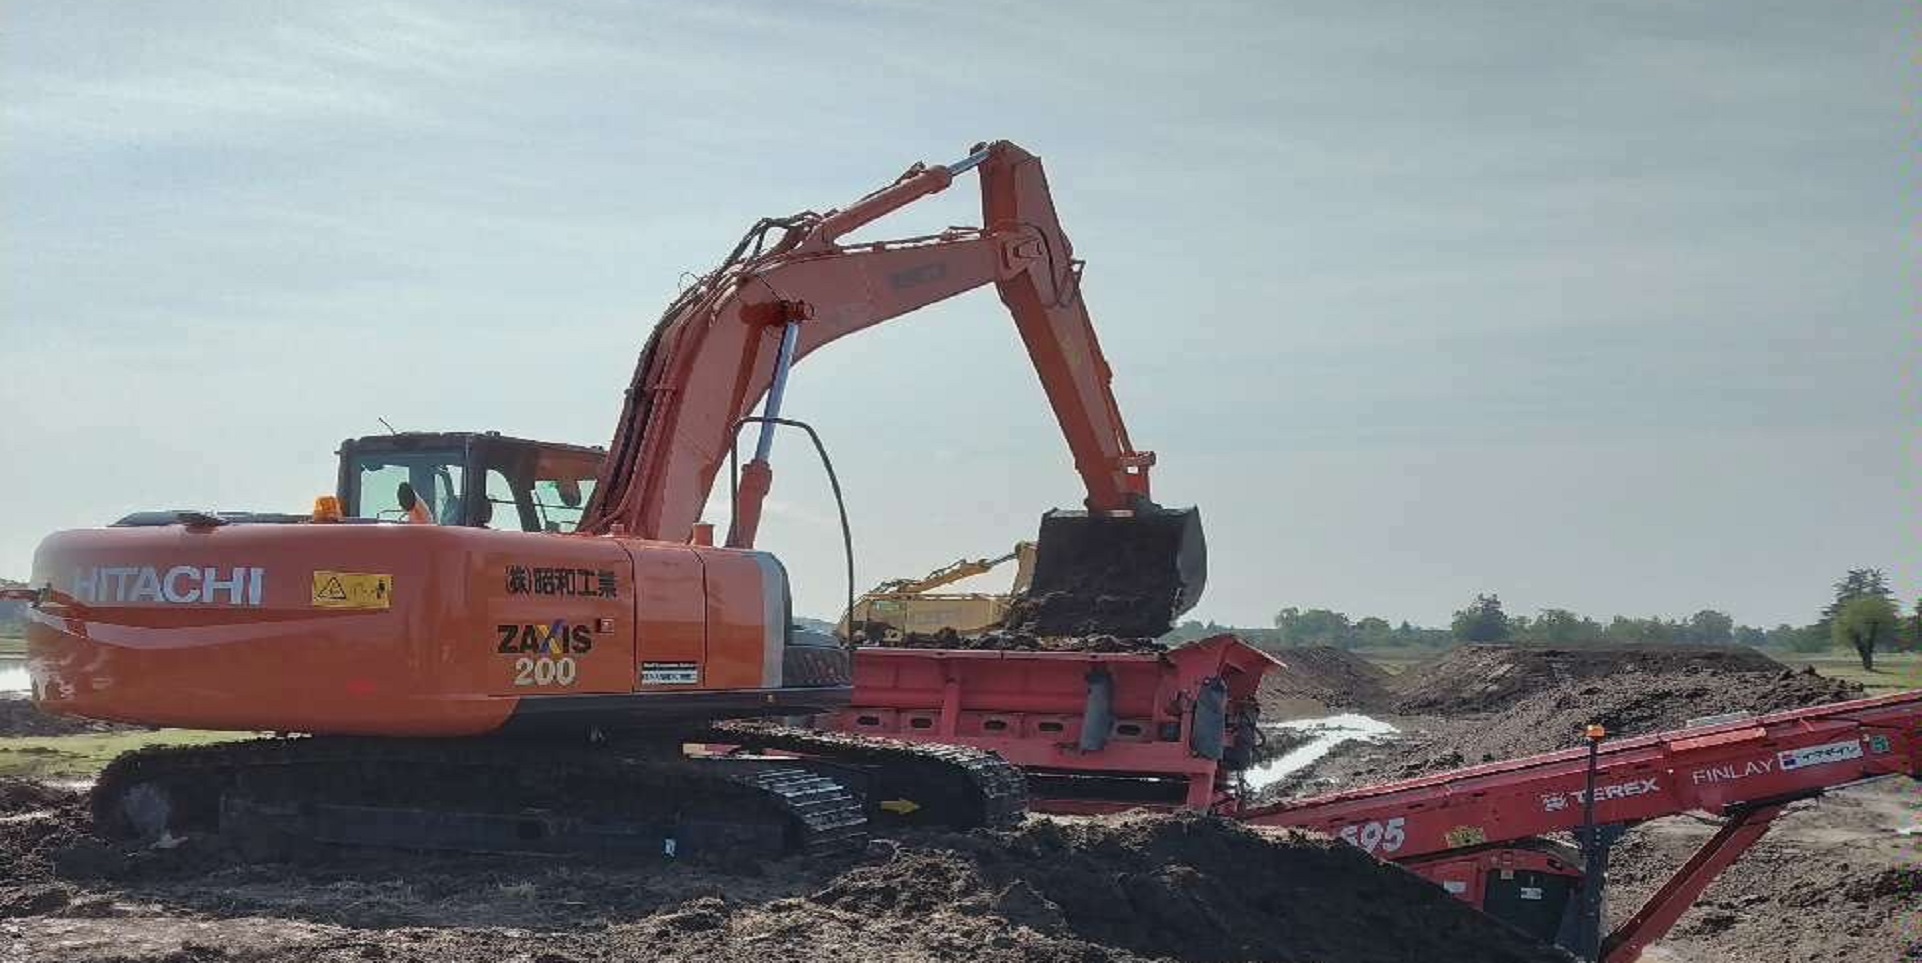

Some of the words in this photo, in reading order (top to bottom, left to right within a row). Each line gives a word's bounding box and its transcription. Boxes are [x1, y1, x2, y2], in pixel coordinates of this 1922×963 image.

[73, 565, 265, 604] HITACHI
[497, 618, 593, 658] ZAXIS
[514, 657, 577, 687] 200
[1569, 778, 1661, 804] TEREX
[1692, 757, 1774, 786] FINLAY
